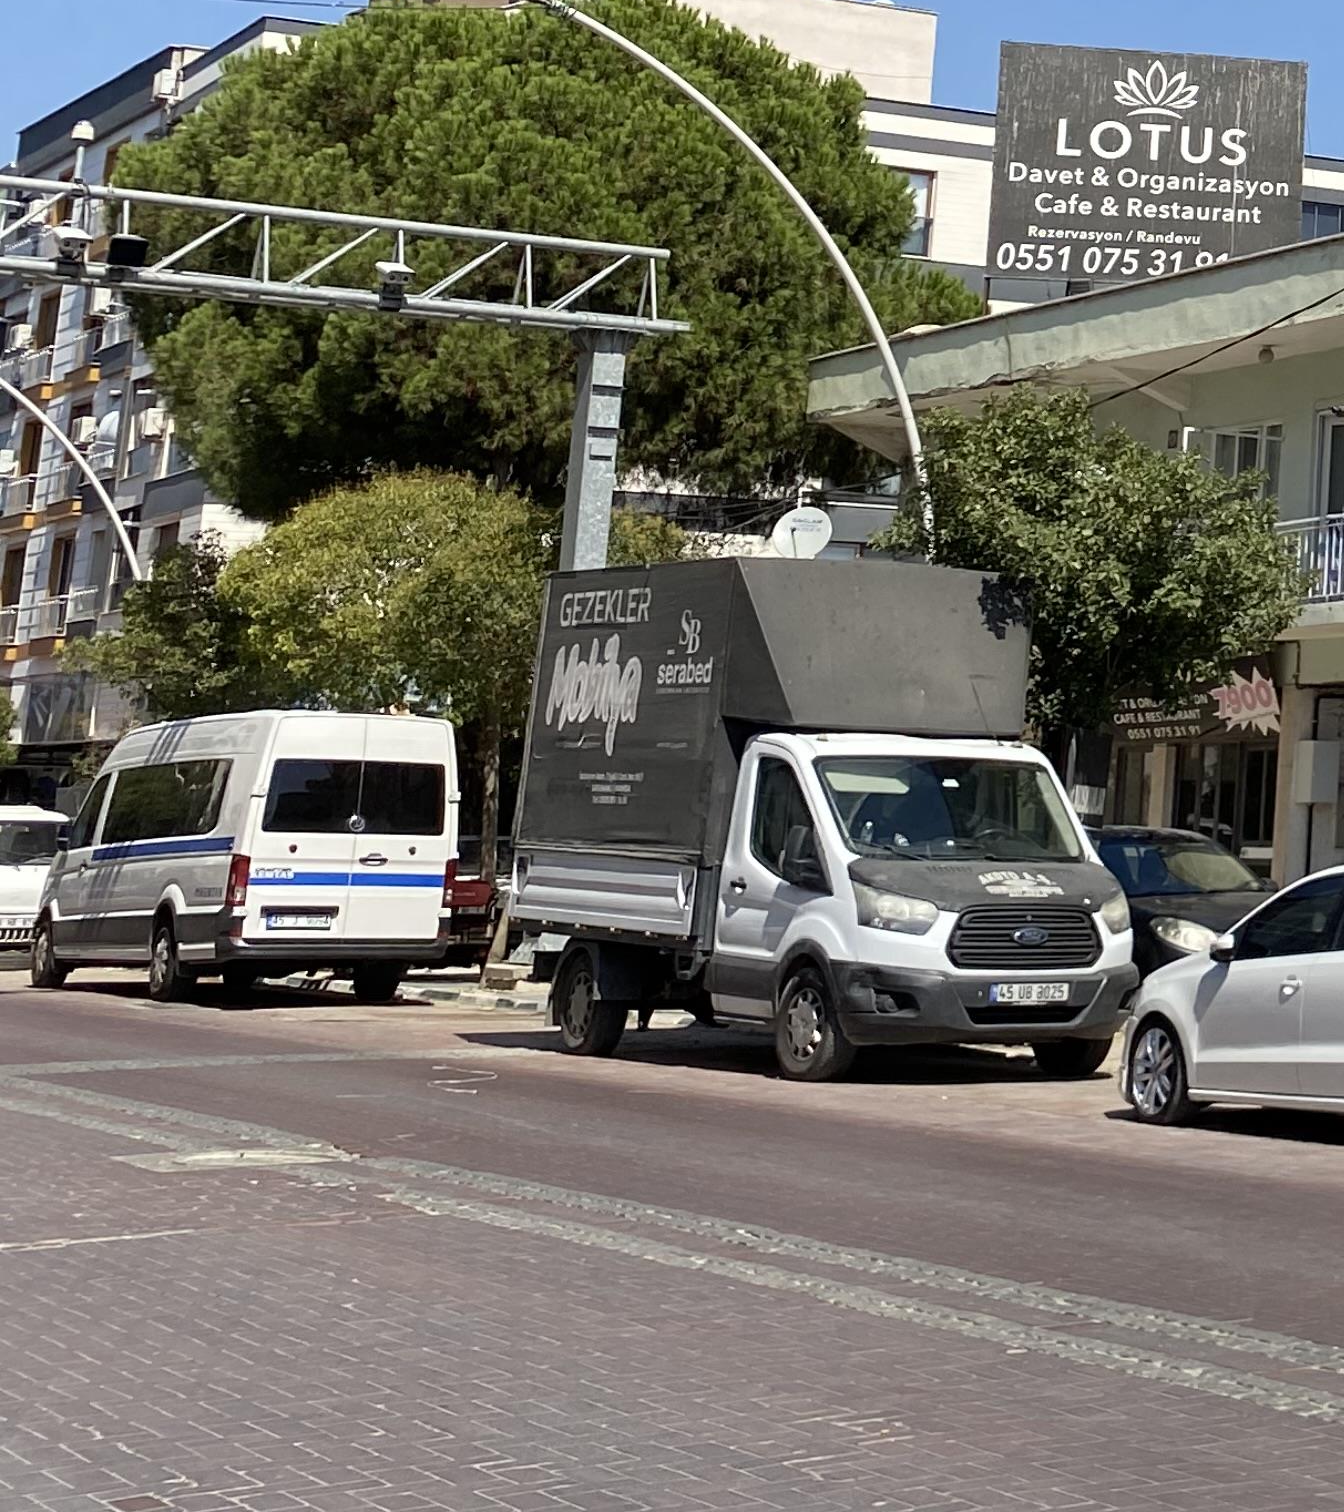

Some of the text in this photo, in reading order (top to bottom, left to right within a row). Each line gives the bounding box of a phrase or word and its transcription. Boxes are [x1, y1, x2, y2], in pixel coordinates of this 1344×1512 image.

[1056, 118, 1249, 166] LOTUS
[1008, 163, 1289, 199] Davet & Organizasyon
[1034, 193, 1261, 224] Cafe & Restaurant
[1028, 225, 1122, 243] Rezervasyon
[1137, 230, 1200, 245] Randevu
[996, 243, 1071, 272] 0551
[1083, 246, 1139, 275] 075
[1147, 249, 1182, 276] 31
[560, 588, 651, 627] GEZEKLER
[657, 657, 713, 684] serabed
[1114, 713, 1136, 725] CAFE
[1127, 728, 1151, 739] 0551
[1154, 727, 1172, 738] 075
[1173, 727, 1186, 736] 31
[1000, 985, 1013, 999] 45
